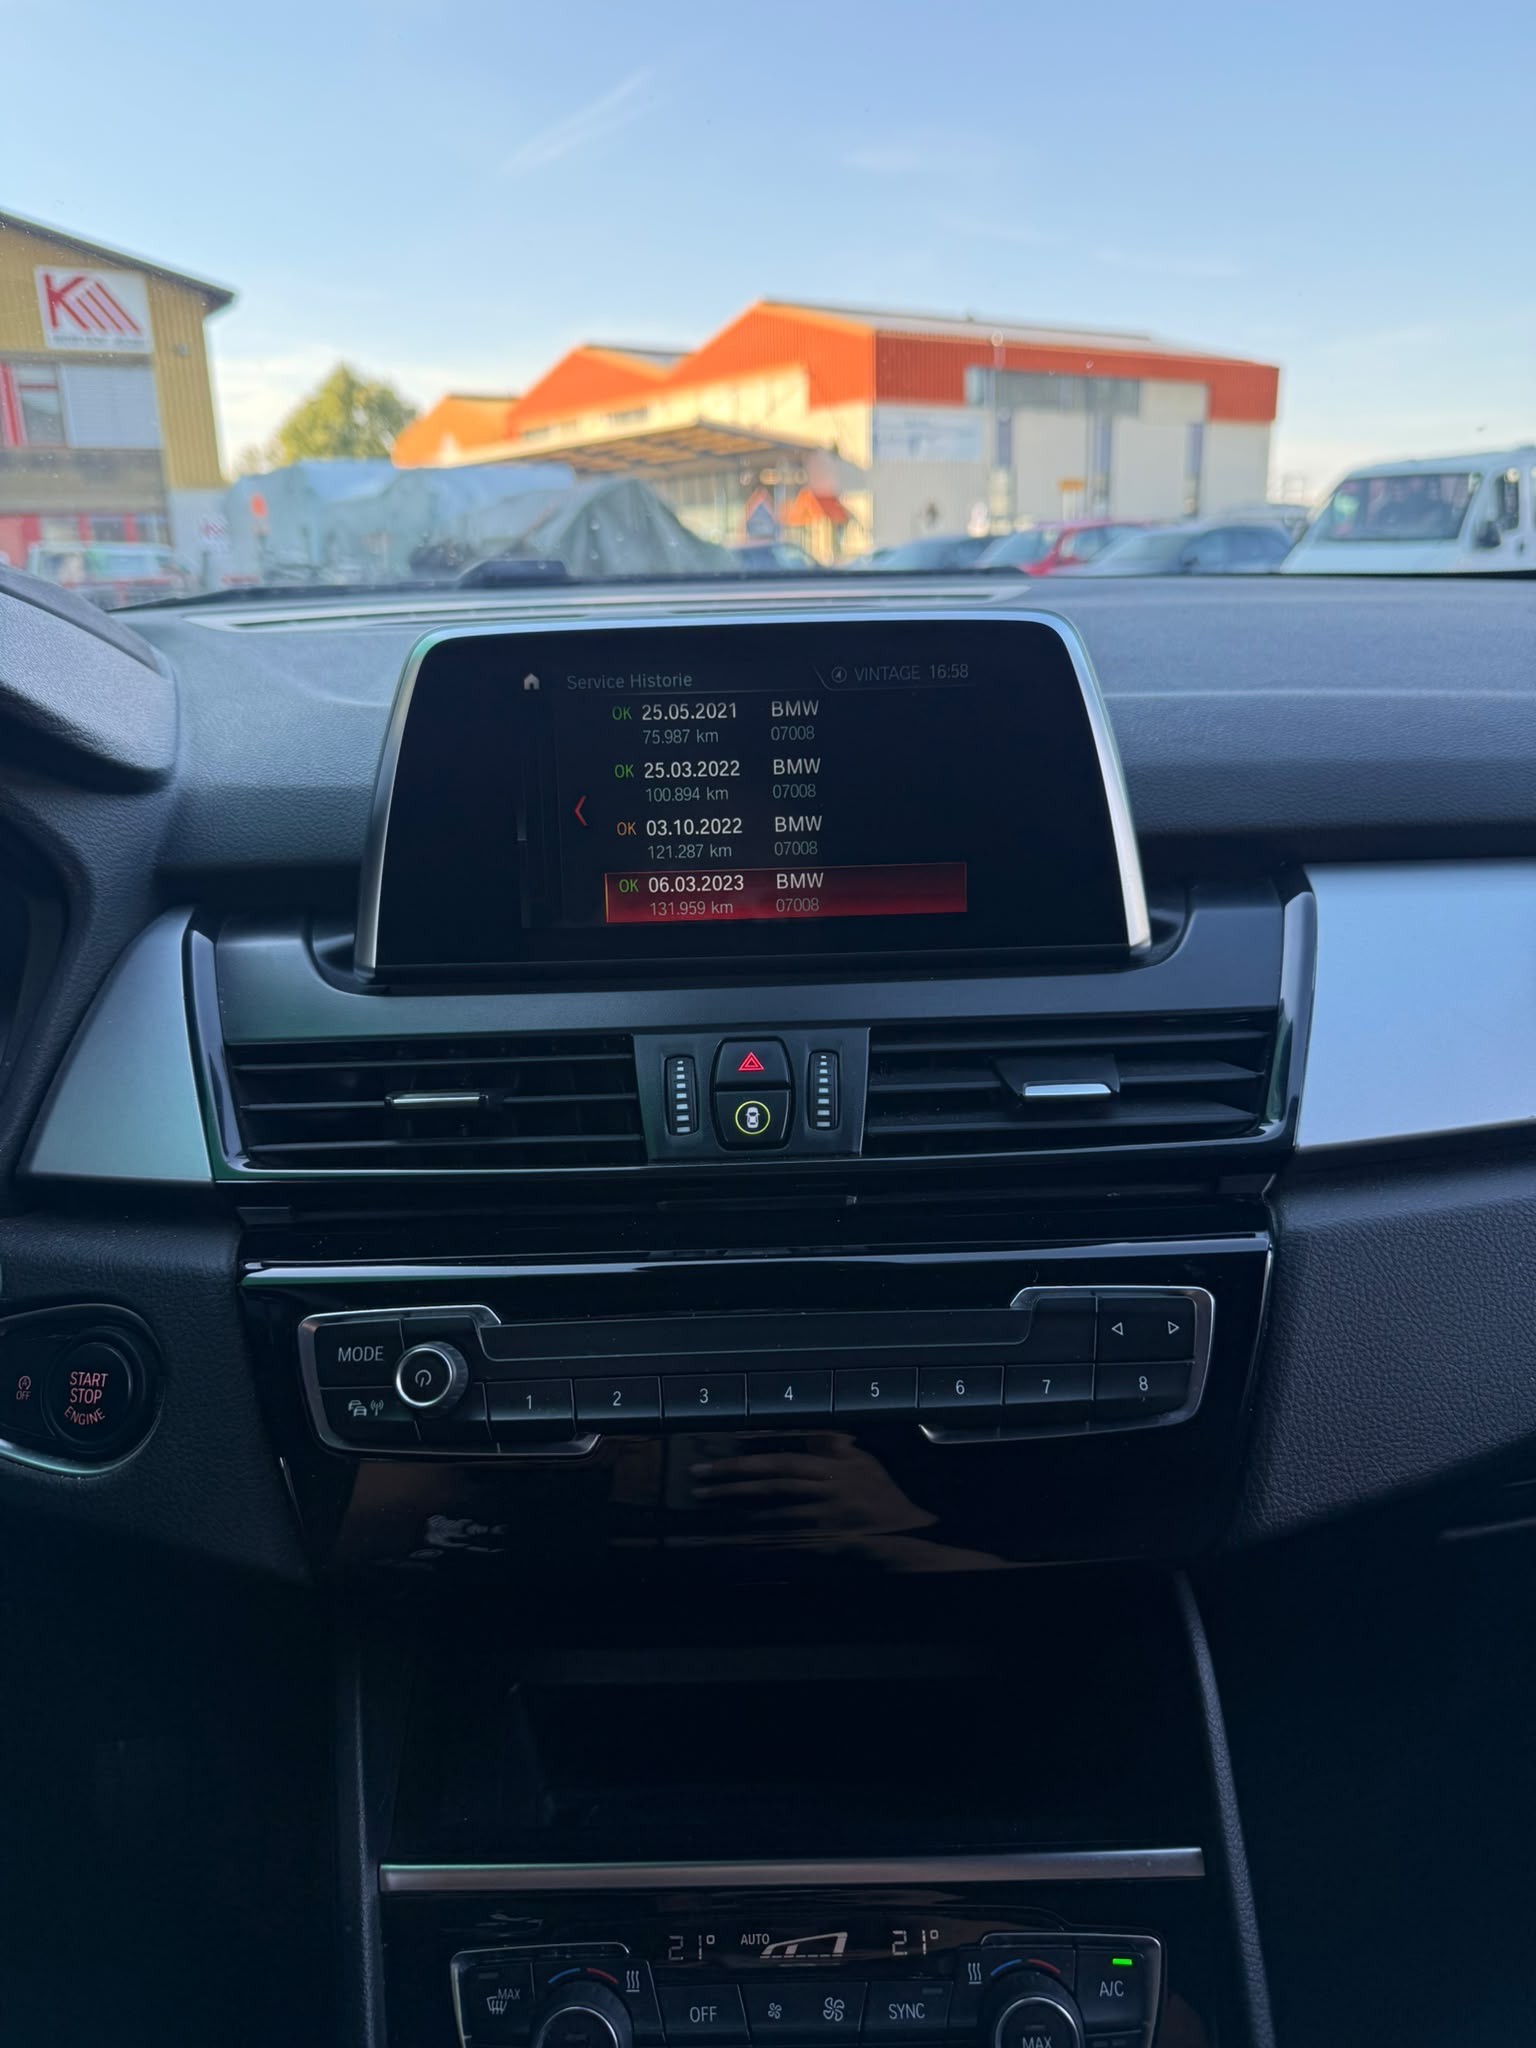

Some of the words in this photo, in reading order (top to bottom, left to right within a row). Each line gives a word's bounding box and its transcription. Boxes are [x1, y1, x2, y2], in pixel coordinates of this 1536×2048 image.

[567, 674, 625, 690] Service
[630, 673, 693, 688] Historie
[855, 665, 921, 681] VINTAGE
[929, 663, 969, 680] 16:58
[612, 705, 633, 721] OK
[641, 703, 738, 721] 25.05.2021
[771, 700, 820, 717] BMW
[642, 729, 691, 745] 75.987
[696, 729, 720, 744] km
[770, 725, 816, 742] 07008
[614, 764, 634, 779] OK
[644, 761, 741, 779] 25.03.2022
[772, 758, 821, 776] BMW
[645, 787, 701, 803] 100.894
[706, 786, 729, 802] km
[772, 784, 817, 799] 07008
[616, 821, 637, 837] OK
[646, 818, 743, 836] 03.10.2022
[774, 816, 823, 833] BMW
[647, 844, 704, 860] 121.287
[710, 844, 732, 859] km
[773, 841, 818, 856] 07008
[618, 879, 639, 894] OK
[648, 875, 745, 893] 06.03.2023
[776, 872, 824, 889] BMW
[649, 901, 706, 917] 131.959
[711, 900, 734, 915] km
[775, 898, 820, 913] 07008
[337, 1345, 385, 1363] MODE
[68, 1370, 109, 1388] START
[15, 1389, 32, 1401] OFF
[69, 1387, 103, 1405] STOP
[525, 1394, 534, 1410] 1
[612, 1390, 623, 1407] 2
[699, 1387, 710, 1404] 3
[784, 1385, 795, 1401] 4
[870, 1381, 881, 1398] 5
[955, 1379, 966, 1396] 6
[1042, 1378, 1053, 1395] 7
[1138, 1375, 1150, 1392] 8
[63, 1404, 106, 1426] ENGINE
[740, 1933, 770, 1946] AUTO
[497, 1987, 521, 2001] MAX
[1099, 1979, 1125, 1998] A/C
[689, 2005, 718, 2024] OFF
[887, 2002, 926, 2021] SYNC
